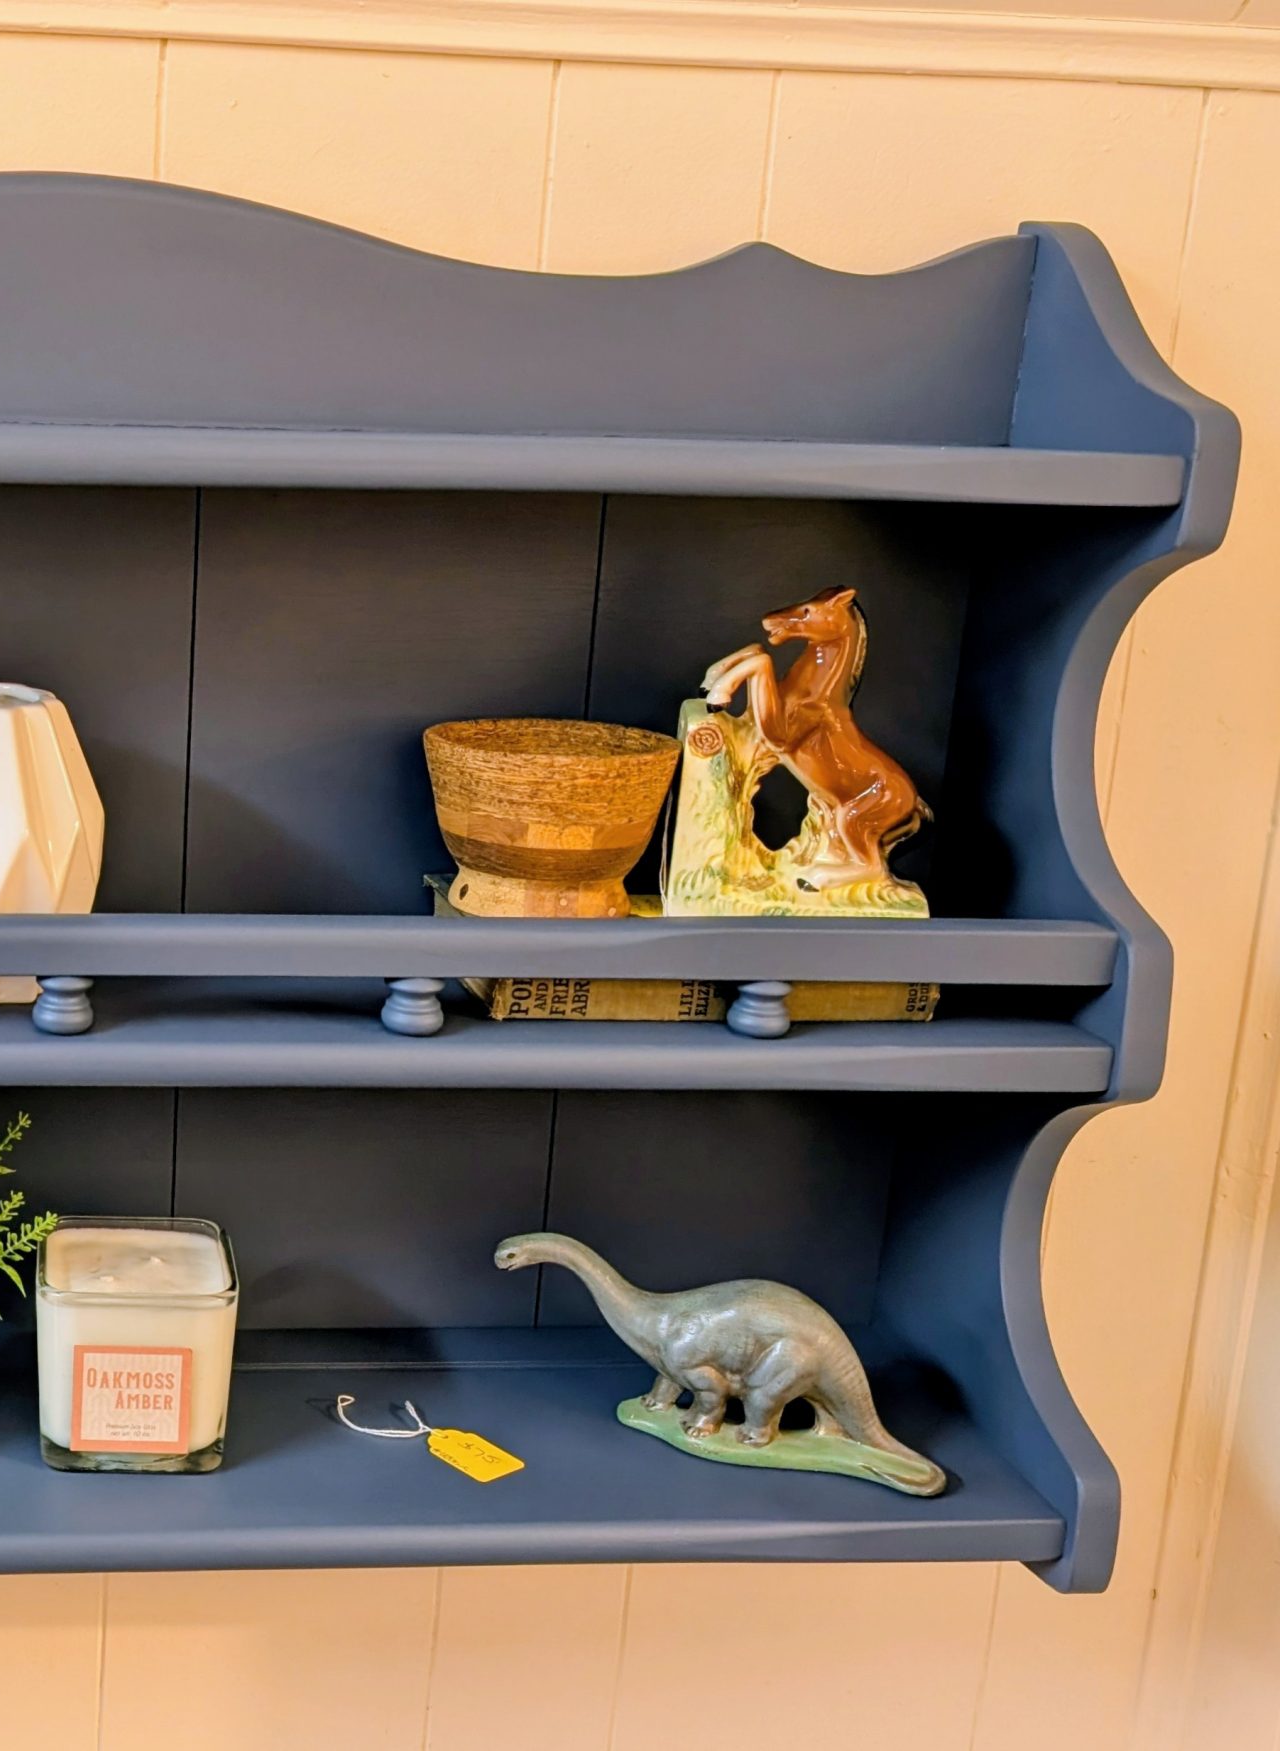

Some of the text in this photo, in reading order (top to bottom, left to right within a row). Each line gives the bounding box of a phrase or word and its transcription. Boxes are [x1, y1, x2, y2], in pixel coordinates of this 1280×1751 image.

[534, 982, 549, 1011] AND
[549, 978, 570, 1016] FRIE
[571, 980, 591, 1016] ABR
[678, 980, 695, 1016] LILL
[87, 1367, 175, 1390] OAKMOSS
[115, 1390, 173, 1410] AMBER
